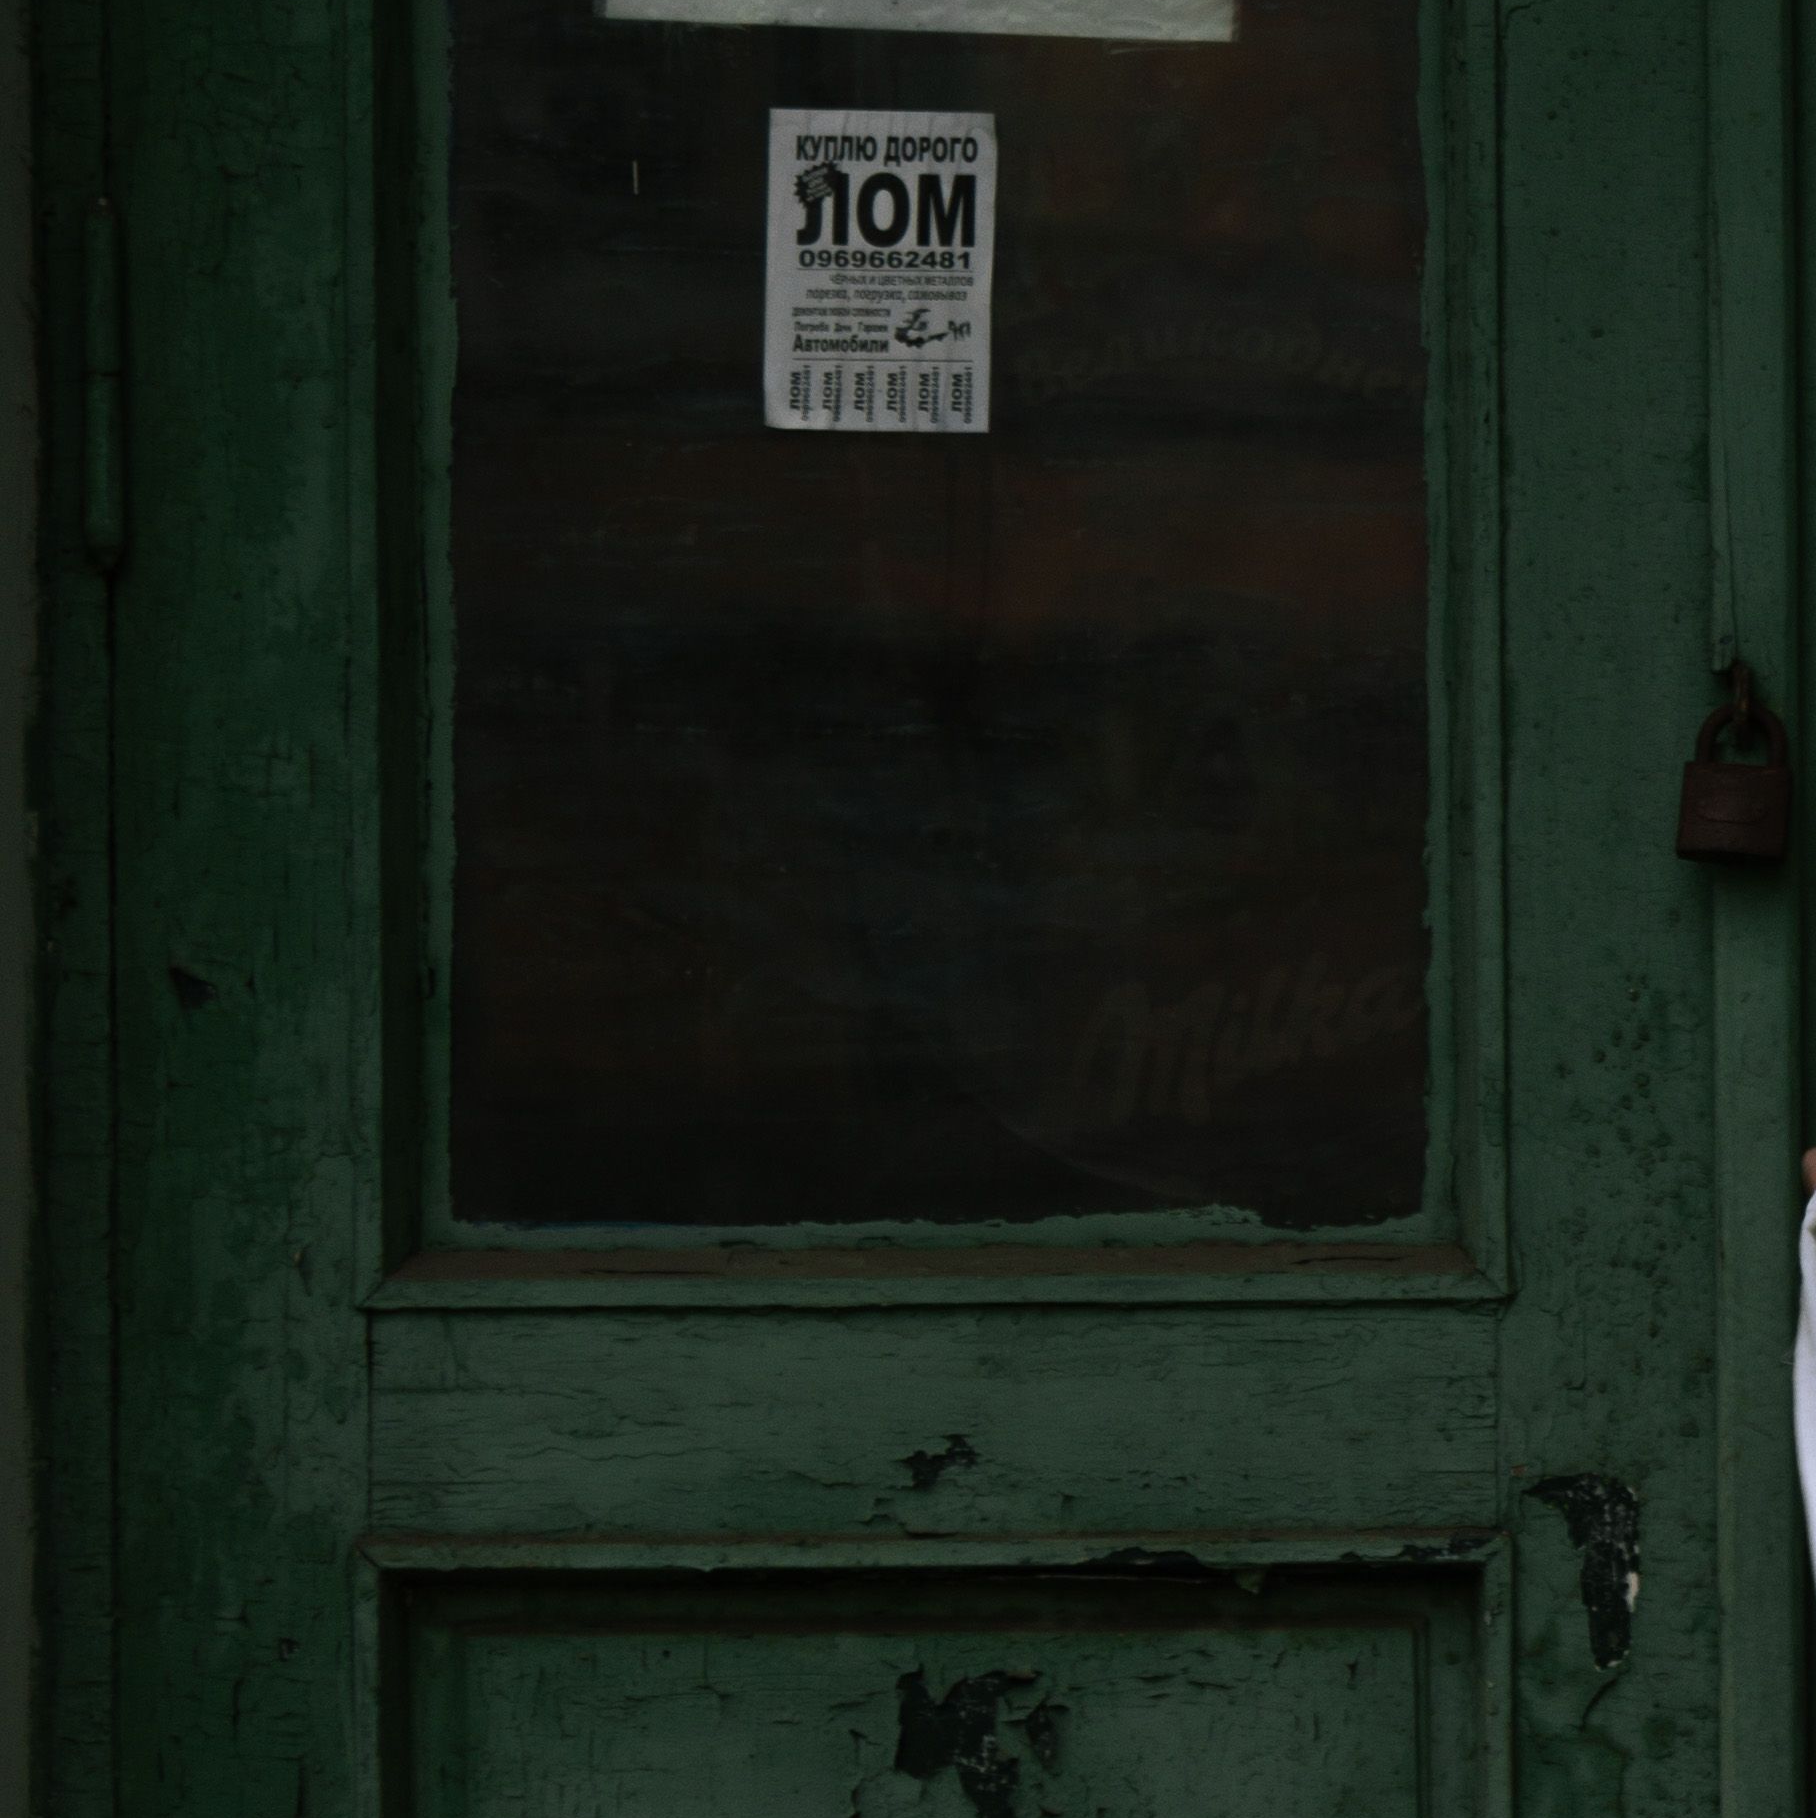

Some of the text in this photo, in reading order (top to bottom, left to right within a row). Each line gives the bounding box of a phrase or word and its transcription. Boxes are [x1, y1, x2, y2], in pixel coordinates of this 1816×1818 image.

[796, 134, 979, 166] КУПЛЮ ДОРОГО
[796, 169, 976, 248] ЛОМ
[800, 250, 972, 270] 0969662481
[792, 334, 890, 353] Автомобили
[789, 371, 801, 412] ЛОМ
[822, 371, 833, 412] ЛОМ
[854, 372, 865, 413] ЛОМ
[886, 372, 898, 413] ЛОМ
[918, 373, 930, 413] ЛОМ
[951, 373, 963, 413] ЛОМ
[1070, 951, 1418, 1127] Milka
